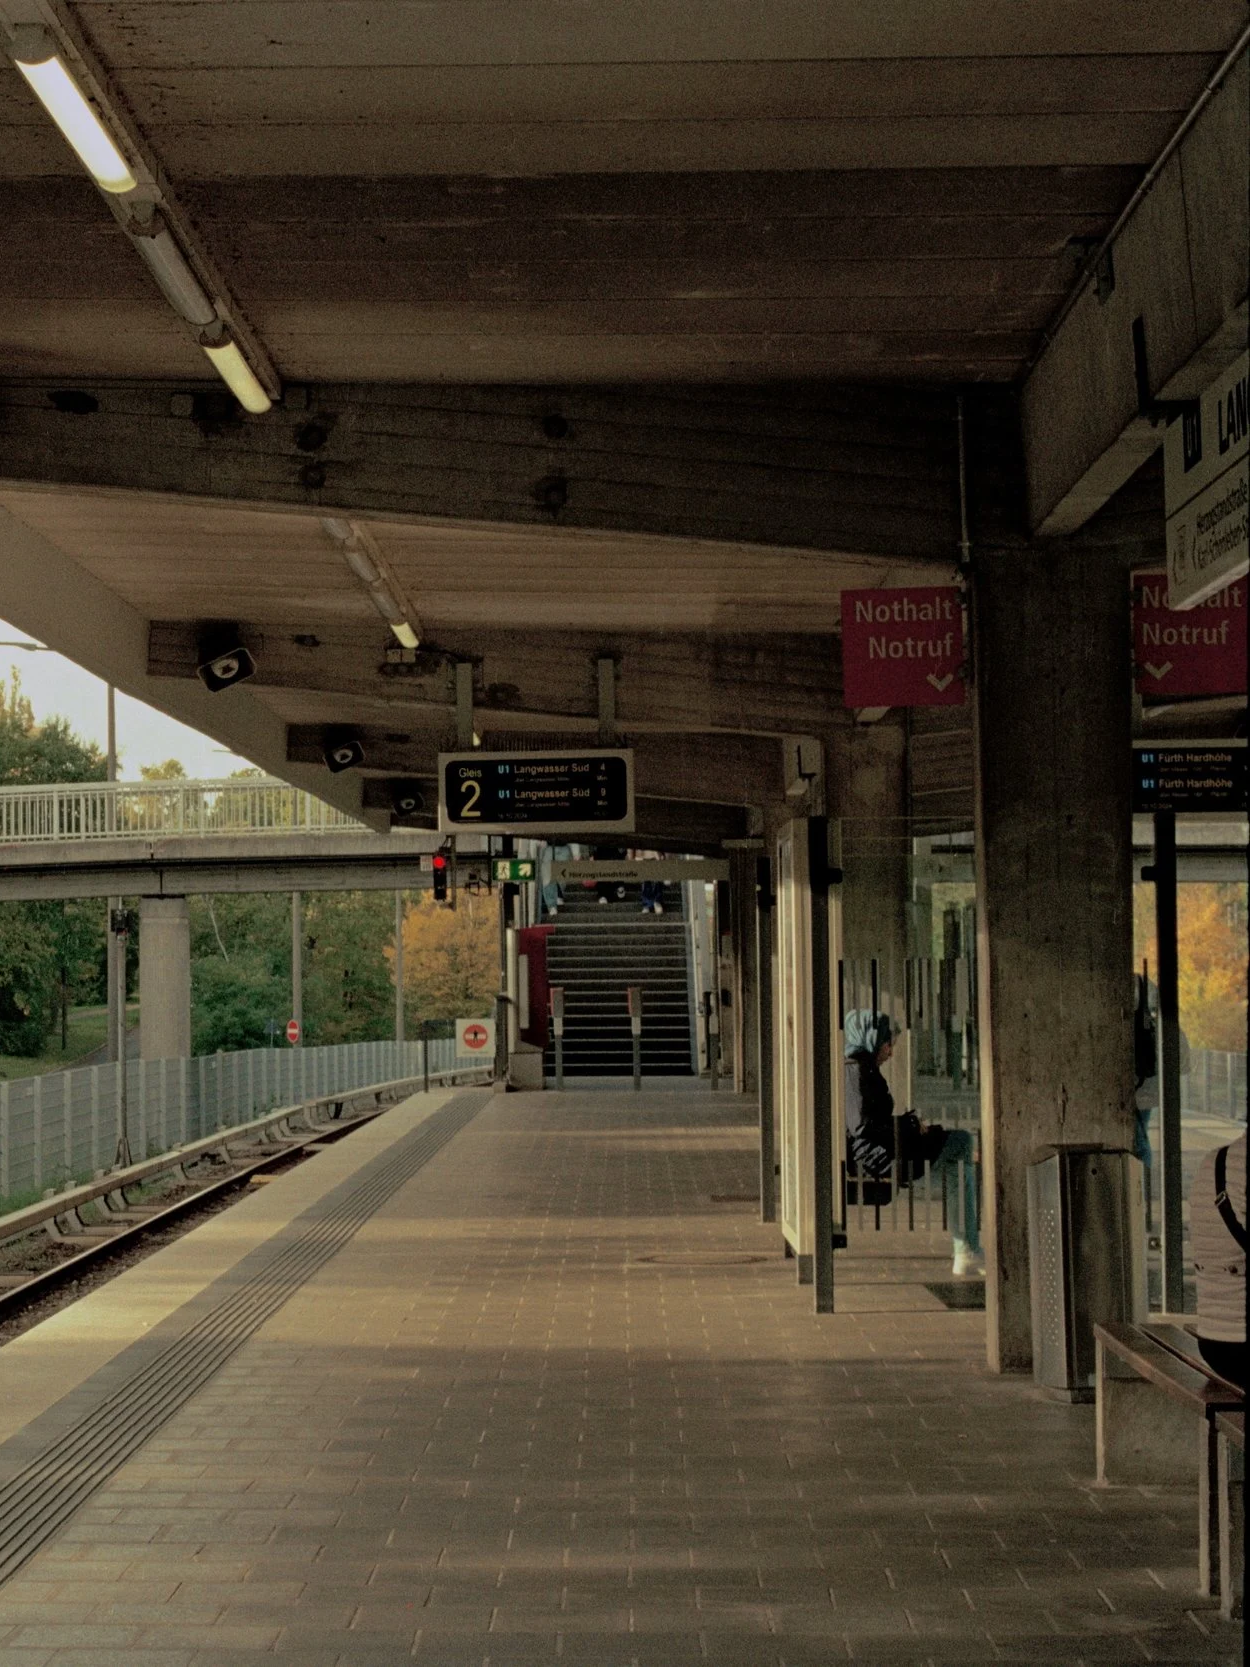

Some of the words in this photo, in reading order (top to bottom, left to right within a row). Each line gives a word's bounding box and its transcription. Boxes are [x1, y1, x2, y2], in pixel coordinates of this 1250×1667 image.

[1142, 585, 1243, 609] Nalt
[854, 596, 954, 624] Nothalt
[1142, 619, 1230, 646] Notruf
[868, 631, 955, 660] Notruf
[1141, 753, 1155, 764] U1
[1158, 752, 1184, 763] Fürth
[1187, 752, 1233, 763] Hardhöhe
[458, 766, 483, 779] Gleis
[498, 764, 510, 774] U1
[514, 763, 569, 776] Langwasser
[1141, 778, 1155, 789] U1
[1158, 778, 1185, 789] Fürth
[1188, 778, 1234, 789] Hardhöhe
[460, 780, 482, 817] 2
[499, 789, 511, 800] U1
[514, 788, 570, 801] Langwasser
[572, 787, 591, 798] Süd
